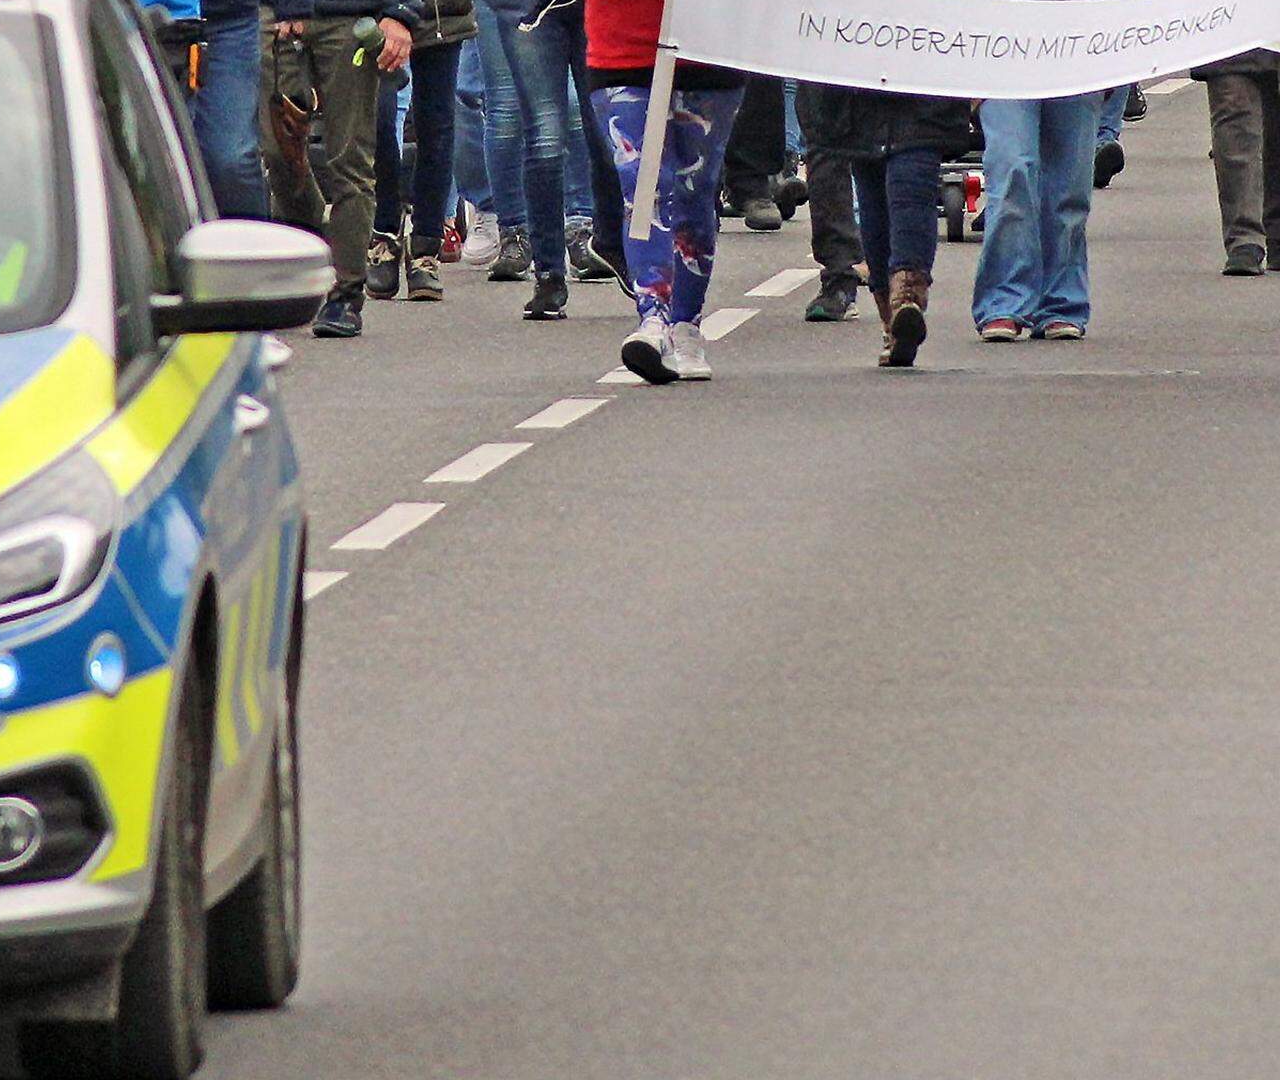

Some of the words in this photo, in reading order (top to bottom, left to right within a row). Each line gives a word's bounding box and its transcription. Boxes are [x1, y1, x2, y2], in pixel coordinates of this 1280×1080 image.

[798, 11, 826, 40] IN
[834, 17, 1030, 60] KOOPERATION
[1035, 34, 1084, 60] MIT
[1086, 2, 1238, 56] QUERDENKEN
